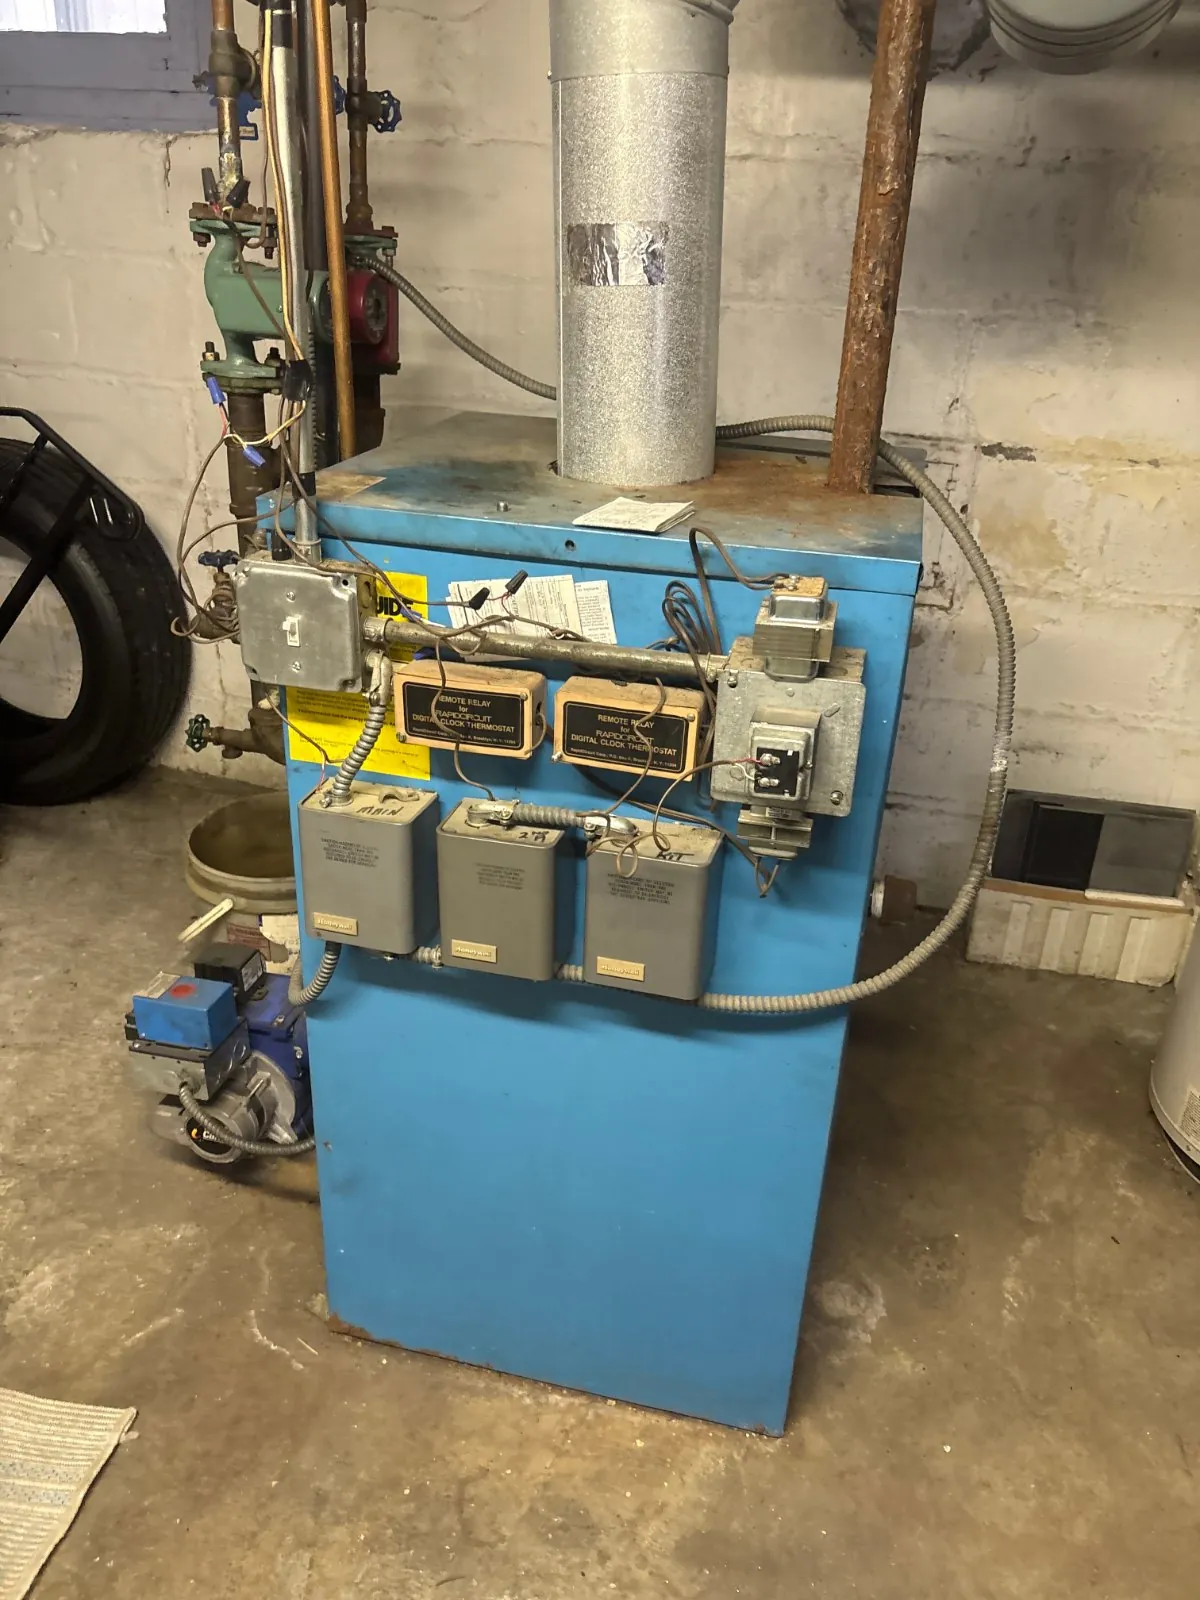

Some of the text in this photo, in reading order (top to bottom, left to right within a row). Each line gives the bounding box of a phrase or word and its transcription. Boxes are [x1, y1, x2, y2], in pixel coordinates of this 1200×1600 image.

[468, 699, 491, 708] RELAY
[412, 713, 515, 733] DIGITA CLOCK THERMOSTAT
[597, 714, 629, 726] REMOTE
[620, 726, 631, 734] for
[571, 733, 598, 745] DIGITAL
[600, 738, 626, 749] CLOCK
[356, 806, 404, 816] MAIN
[655, 851, 695, 861] KIT
